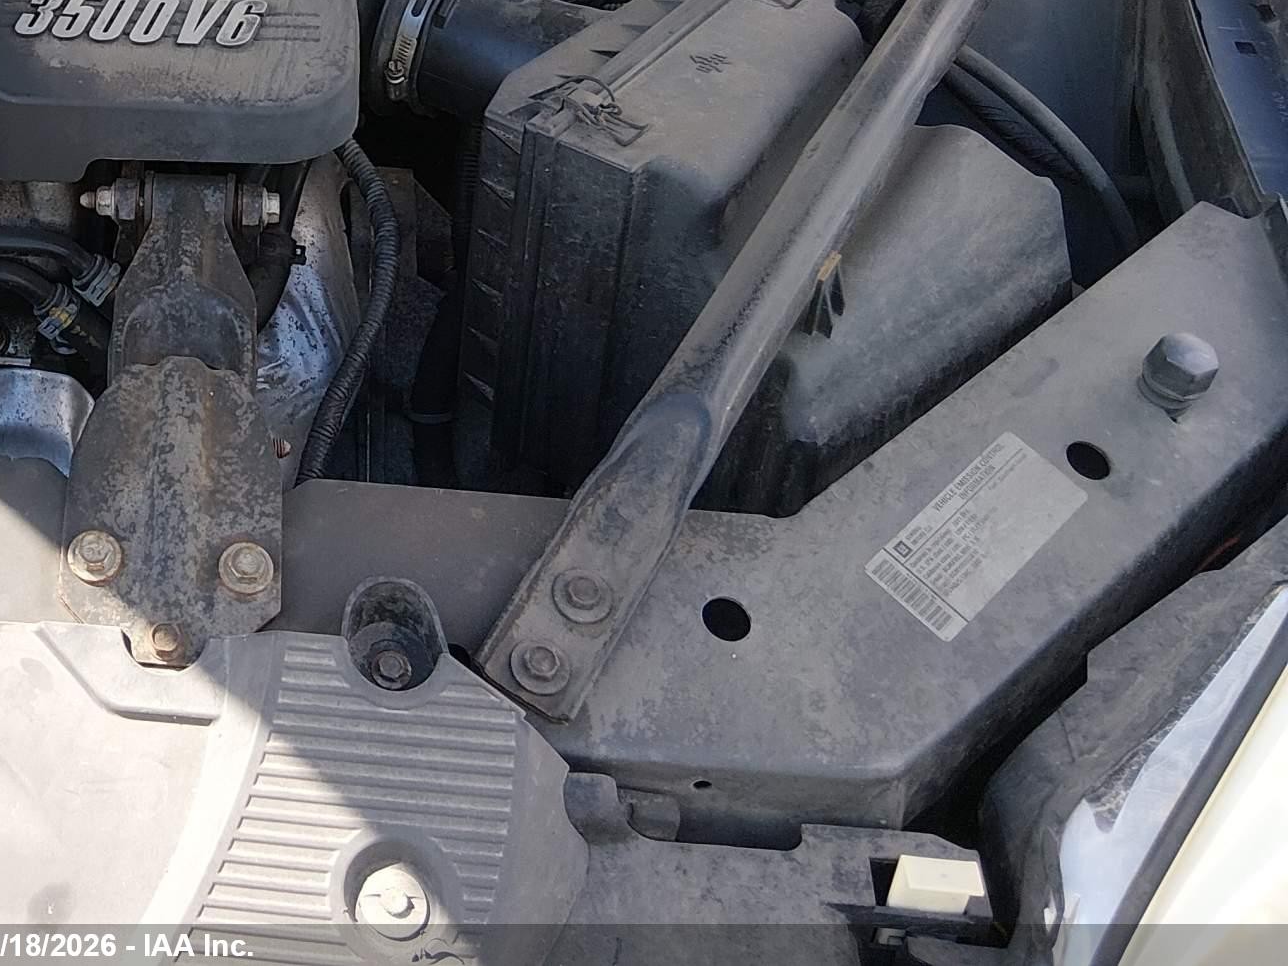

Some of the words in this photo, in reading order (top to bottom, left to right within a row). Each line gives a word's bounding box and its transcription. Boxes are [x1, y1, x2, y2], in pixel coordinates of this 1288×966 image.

[931, 484, 958, 513] VEHICLE
[952, 460, 984, 491] EMISSION
[977, 442, 1006, 469] CONTROL
[957, 464, 997, 501] INFORMATION
